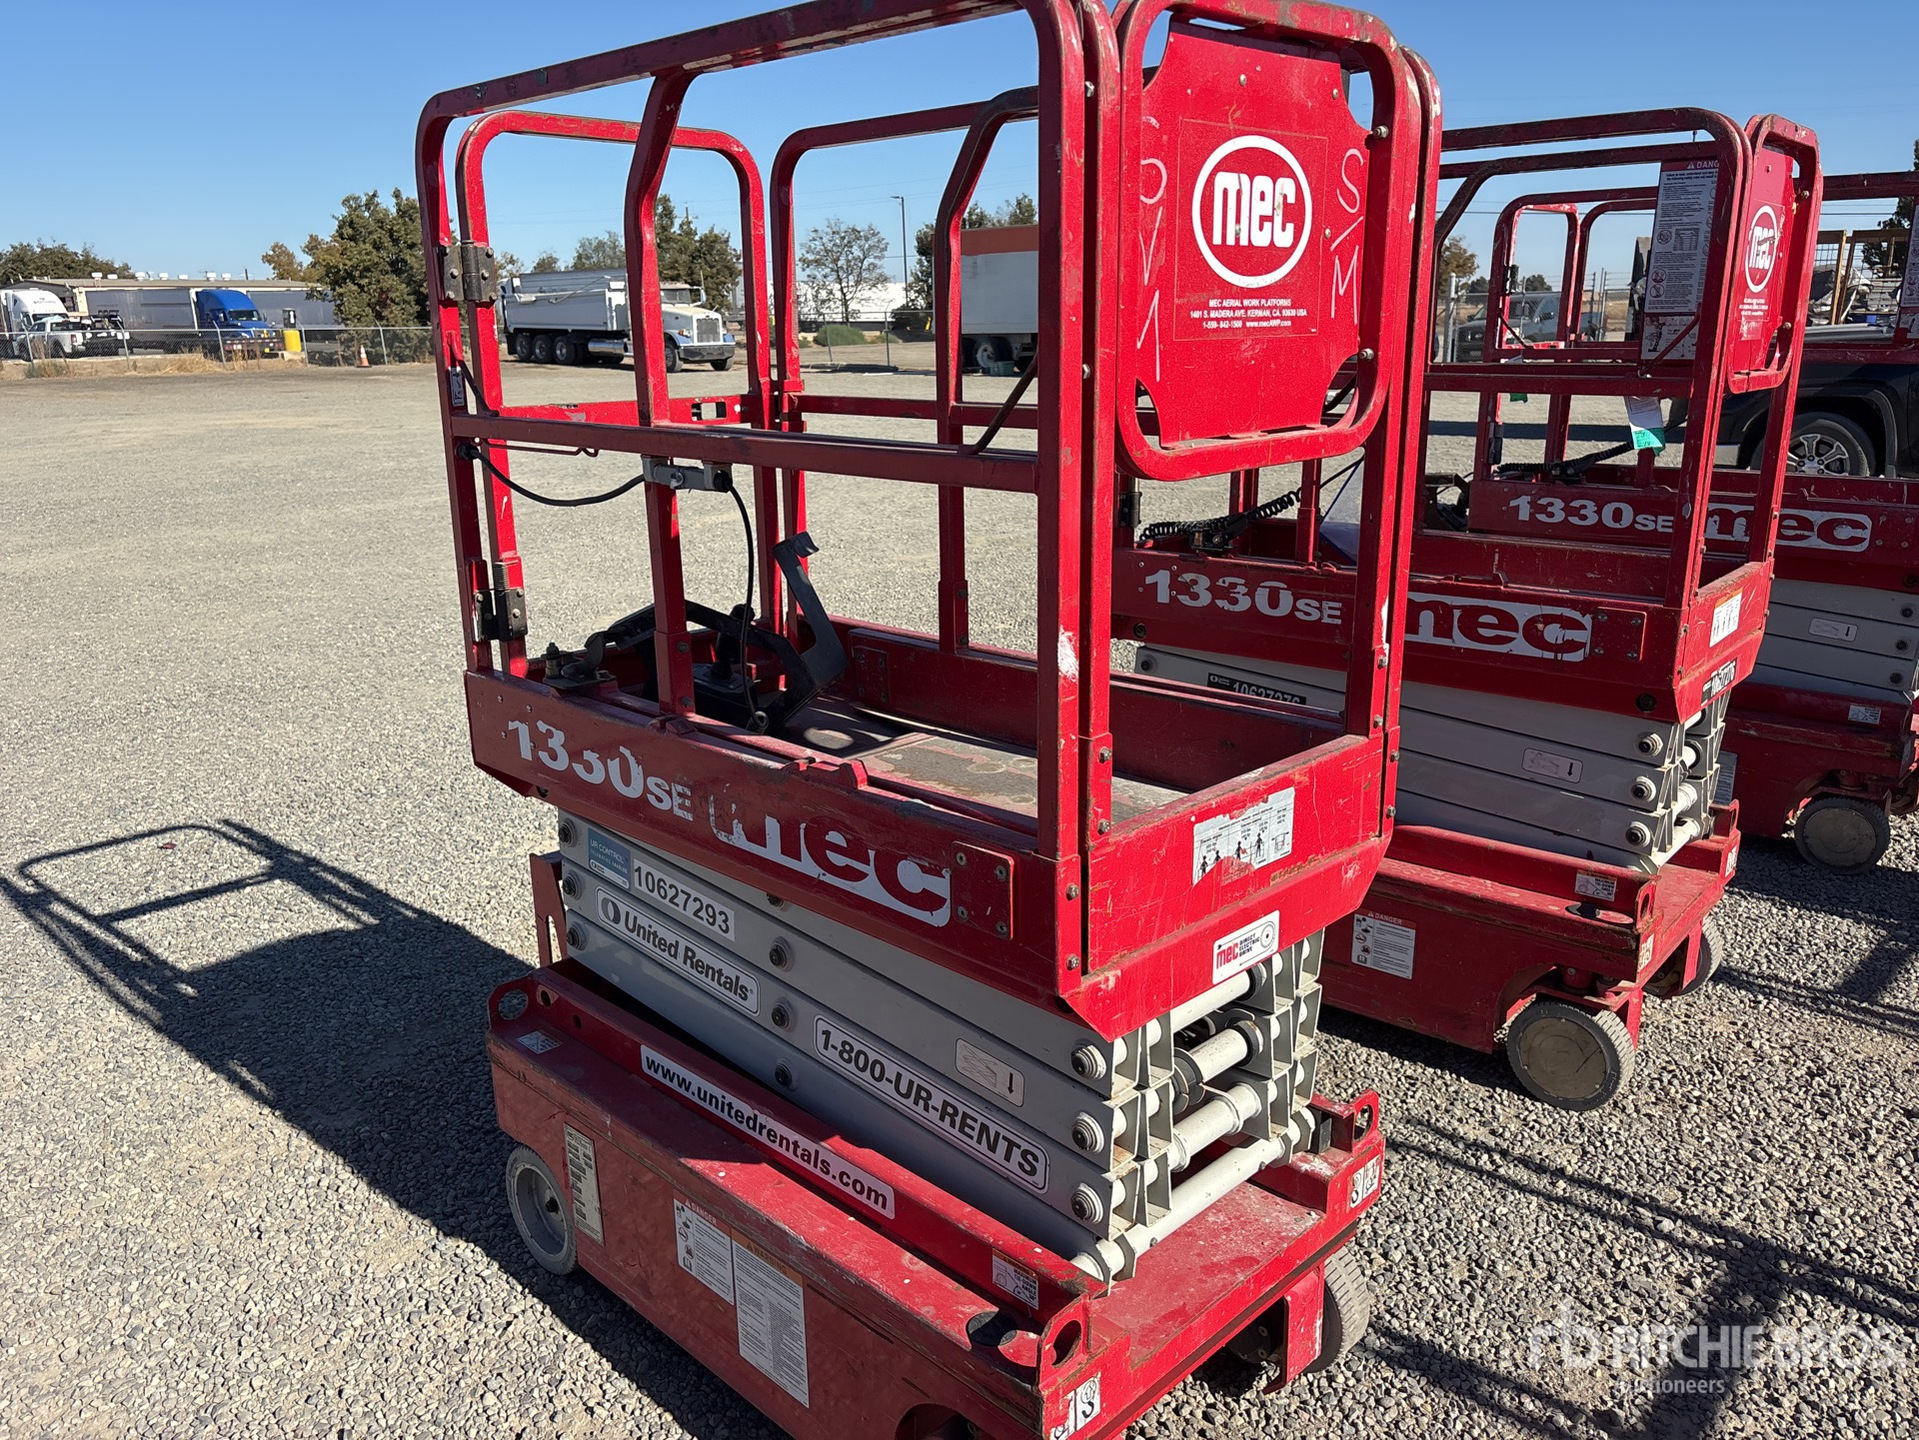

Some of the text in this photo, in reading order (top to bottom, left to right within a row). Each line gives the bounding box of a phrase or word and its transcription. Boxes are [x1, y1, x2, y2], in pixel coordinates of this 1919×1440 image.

[1696, 160, 1719, 169] DANG
[1209, 298, 1292, 308] MEC AERIAL WORK PLATFORMS
[1210, 309, 1234, 318] MADERA
[1296, 308, 1307, 317] USA
[1508, 495, 1673, 534] 1330SE
[1144, 569, 1342, 625] 1330SE
[599, 844, 625, 864] CONTROL
[634, 865, 730, 935] 10627293
[1375, 912, 1402, 924] DANGER
[624, 910, 750, 1001] United Rentals
[1216, 942, 1239, 970] mec
[820, 1029, 1040, 1177] 1-800-UR-RENTS
[646, 1054, 888, 1211] www.unitedrentals.com
[691, 1202, 717, 1226] DANGER
